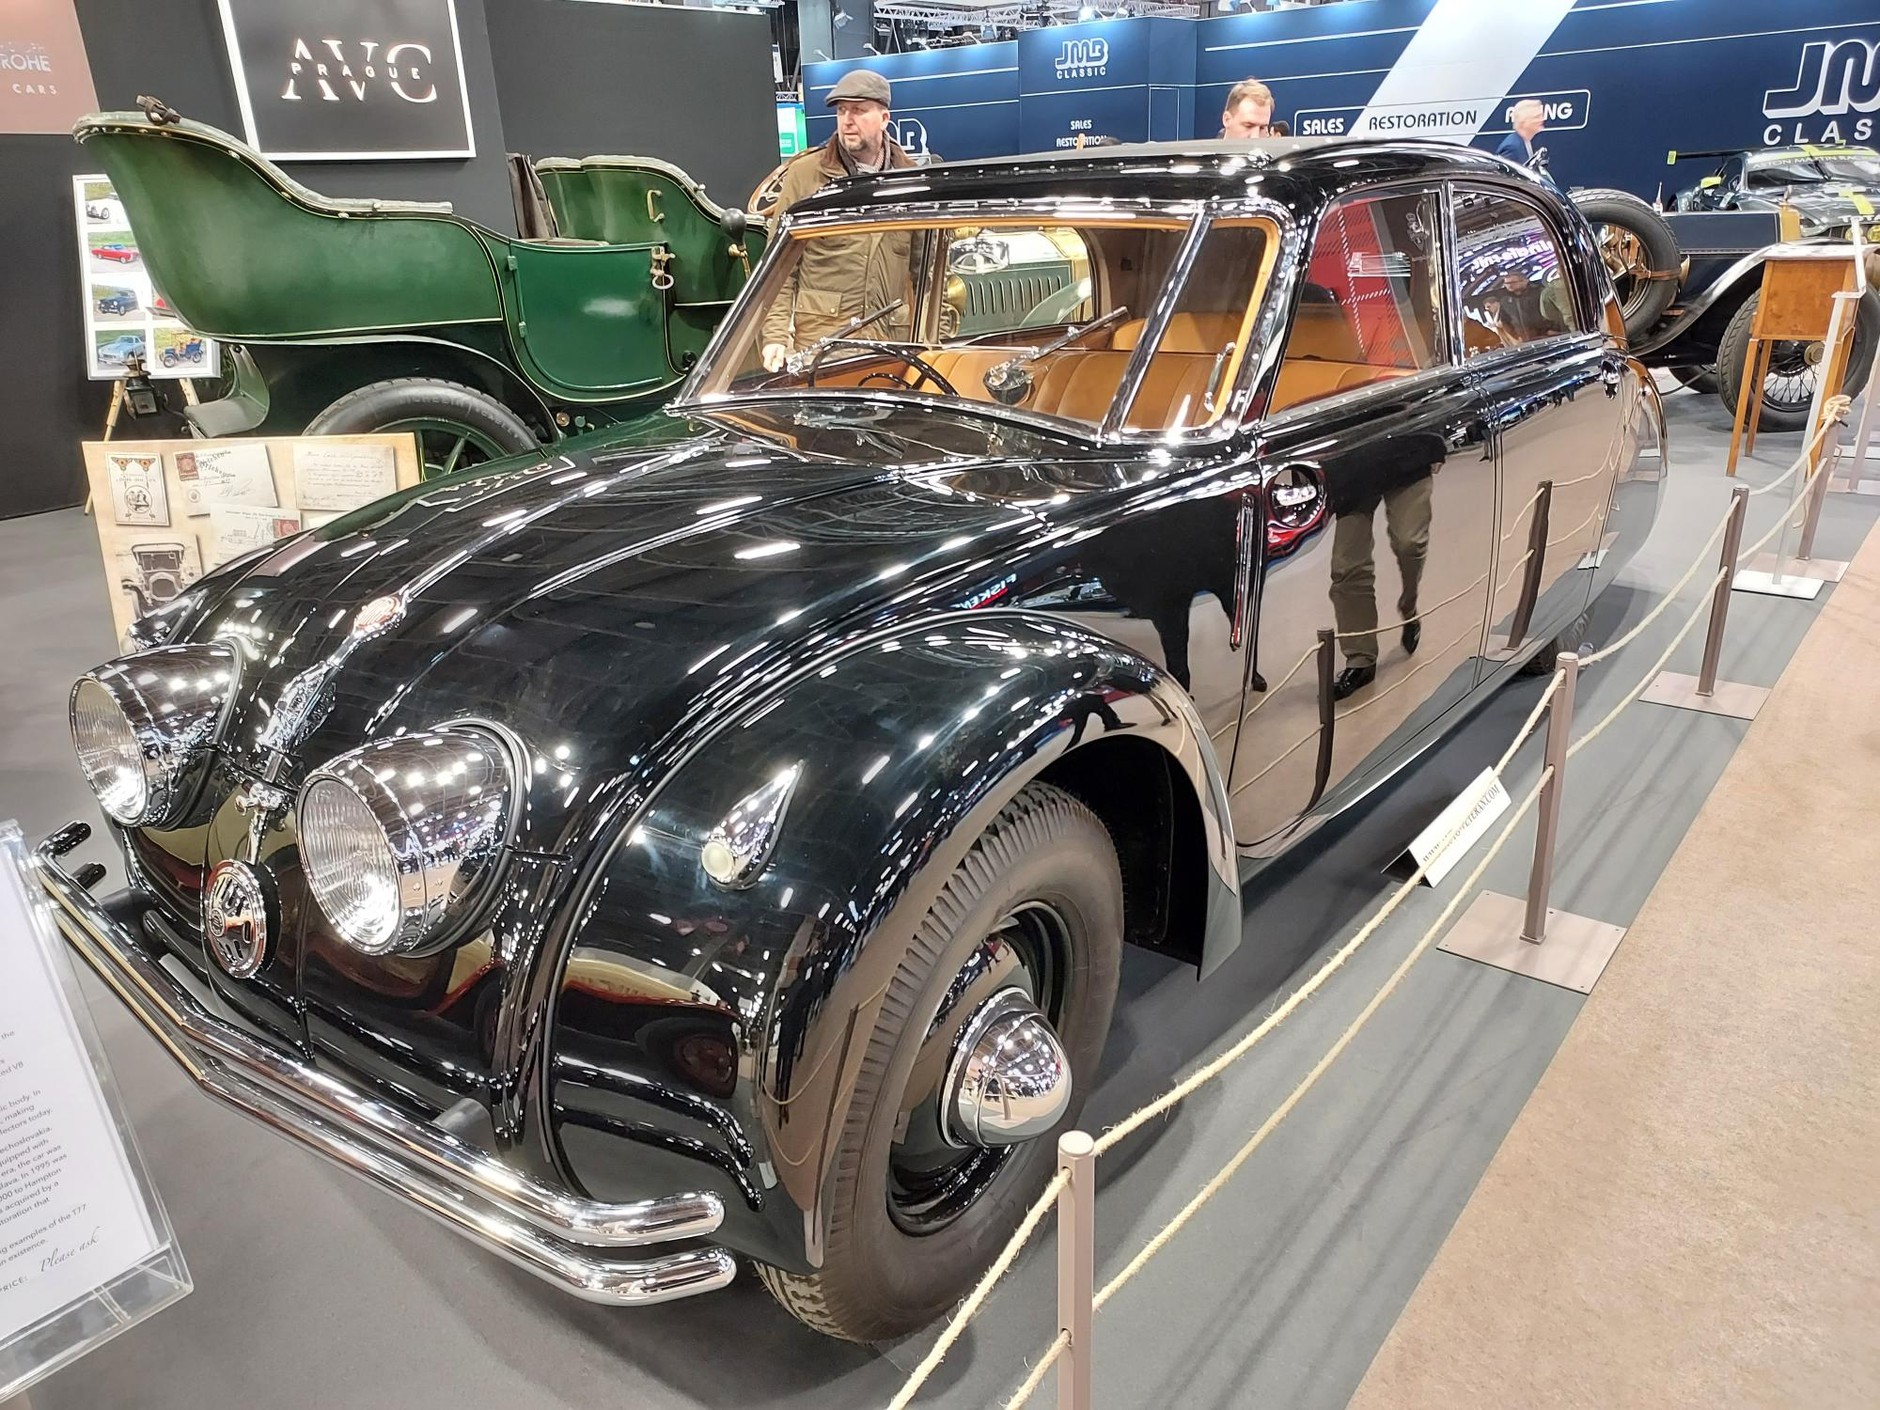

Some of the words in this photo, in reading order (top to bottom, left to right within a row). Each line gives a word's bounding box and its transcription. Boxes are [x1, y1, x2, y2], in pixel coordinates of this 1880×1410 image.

[1055, 37, 1108, 69] JMB
[281, 38, 437, 103] AVC
[291, 61, 421, 80] PRAGUE
[1056, 66, 1106, 80] CLASSIC
[12, 83, 57, 95] CARS
[1070, 119, 1092, 130] SALES
[1302, 117, 1344, 135] SALES
[1369, 110, 1478, 131] RESTORATION
[1504, 102, 1573, 123] RING
[1056, 134, 1107, 148] RESTOATIO
[5, 1105, 35, 1121] making
[28, 1108, 54, 1122] today.
[32, 1138, 49, 1151] with
[18, 1159, 31, 1169] the
[33, 1152, 45, 1161] car
[46, 1144, 62, 1156] was
[31, 1160, 51, 1174] 1995
[52, 1153, 67, 1164] was
[15, 1186, 24, 1195] to
[24, 1167, 62, 1190] Hampton
[5, 1188, 42, 1211] acquired
[41, 1183, 52, 1193] by
[34, 1196, 51, 1209] that
[9, 1226, 47, 1249] examples
[48, 1218, 57, 1229] of
[57, 1212, 71, 1224] the
[72, 1203, 87, 1216] T77
[8, 1238, 49, 1261] existence.
[41, 1247, 75, 1272] Please
[79, 1225, 101, 1251] ask
